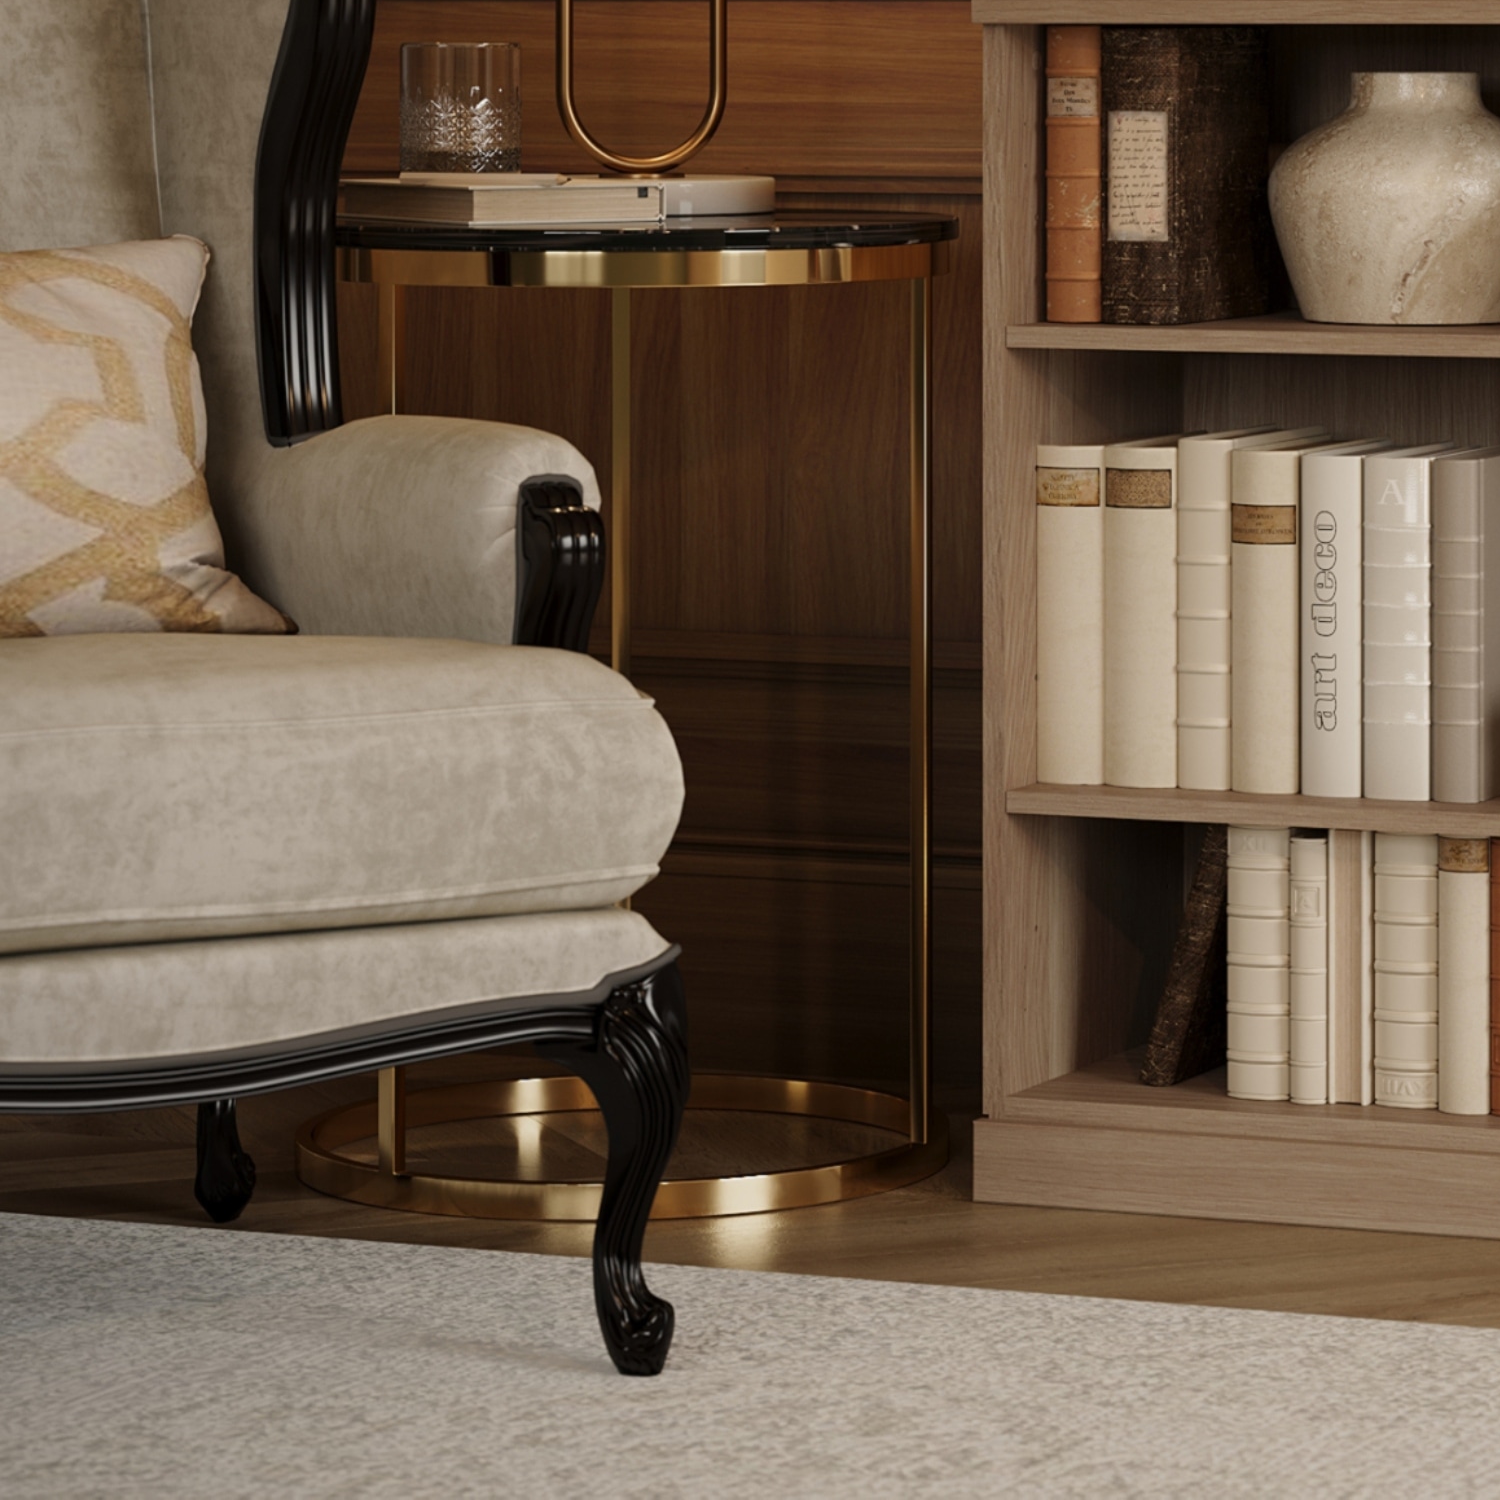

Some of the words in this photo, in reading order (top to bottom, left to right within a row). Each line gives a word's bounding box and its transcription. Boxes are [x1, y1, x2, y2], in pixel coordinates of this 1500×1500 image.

[1377, 479, 1406, 505] A
[1311, 510, 1337, 638] deco
[1311, 652, 1337, 732] art
